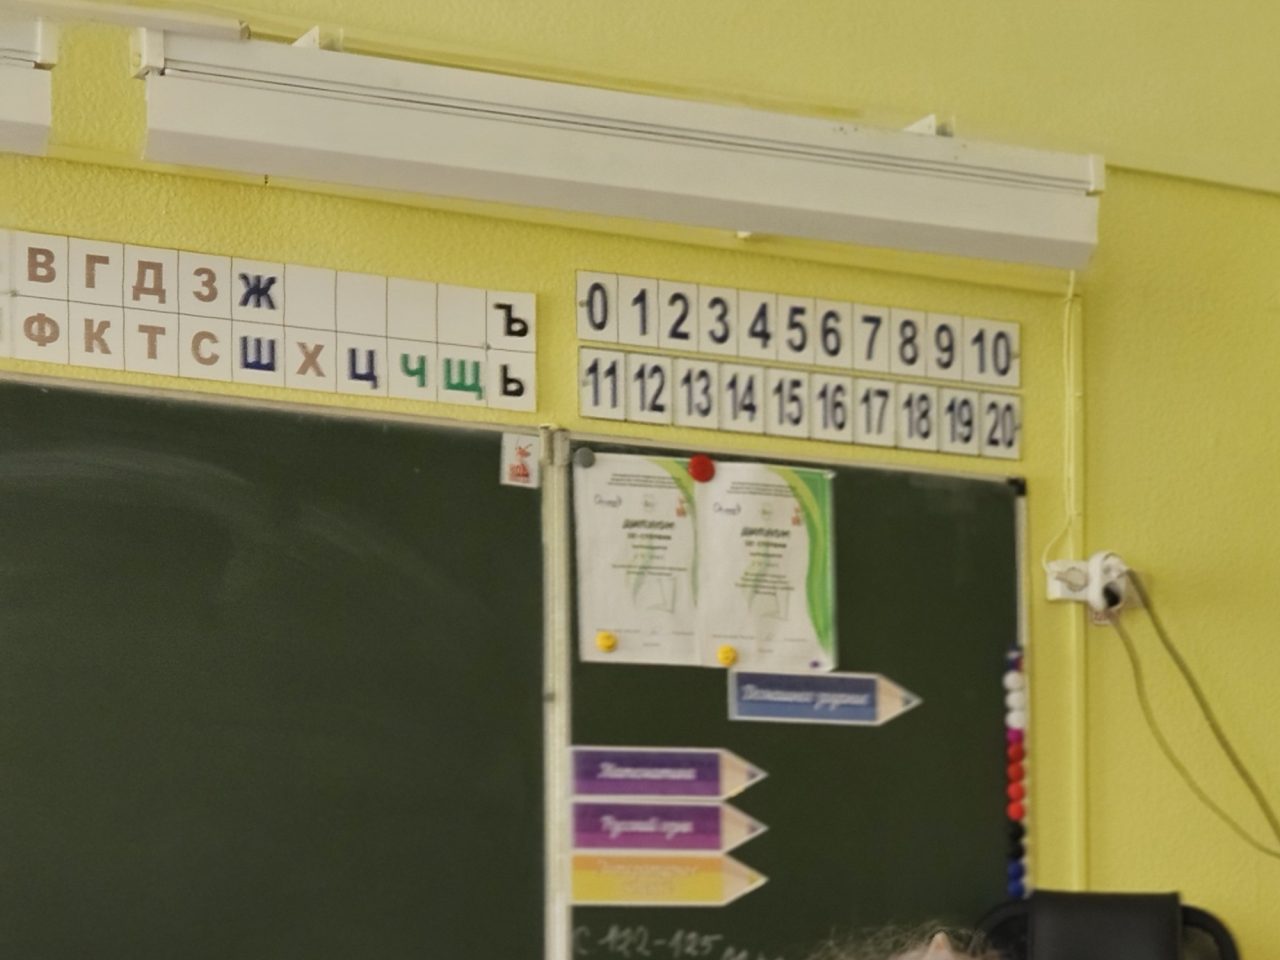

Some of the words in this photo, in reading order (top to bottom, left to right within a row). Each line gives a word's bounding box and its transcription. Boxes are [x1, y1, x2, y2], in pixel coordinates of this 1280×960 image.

[26, 246, 58, 284] В
[84, 253, 111, 289] Г
[130, 259, 168, 305] Д
[191, 267, 220, 303] З
[237, 273, 278, 310] Ж
[492, 302, 530, 338] Ъ
[583, 282, 610, 331] 0
[630, 288, 649, 336] 1
[667, 292, 691, 341] 2
[707, 296, 731, 345] 3
[747, 302, 773, 349] 4
[786, 306, 809, 353] 5
[819, 310, 843, 357] 6
[860, 314, 884, 360] 7
[898, 319, 920, 366] 8
[933, 323, 956, 370] 9
[970, 328, 1013, 377] 10
[22, 312, 61, 348] Ф
[82, 317, 114, 355] К
[136, 323, 168, 360] Т
[189, 330, 221, 366] С
[239, 335, 277, 372] Ш
[294, 341, 327, 378] Х
[347, 347, 380, 390] Ц
[399, 353, 428, 388] Ч
[442, 358, 485, 400] Щ
[499, 364, 526, 398] Ь
[585, 358, 619, 408] 11
[633, 363, 667, 413] 12
[680, 369, 713, 417] 13
[726, 373, 758, 421] 14
[772, 378, 804, 426] 15
[817, 383, 848, 431] 16
[859, 388, 891, 433] 17
[902, 393, 933, 440] 18
[944, 398, 975, 444] 19
[986, 401, 1016, 449] 20
